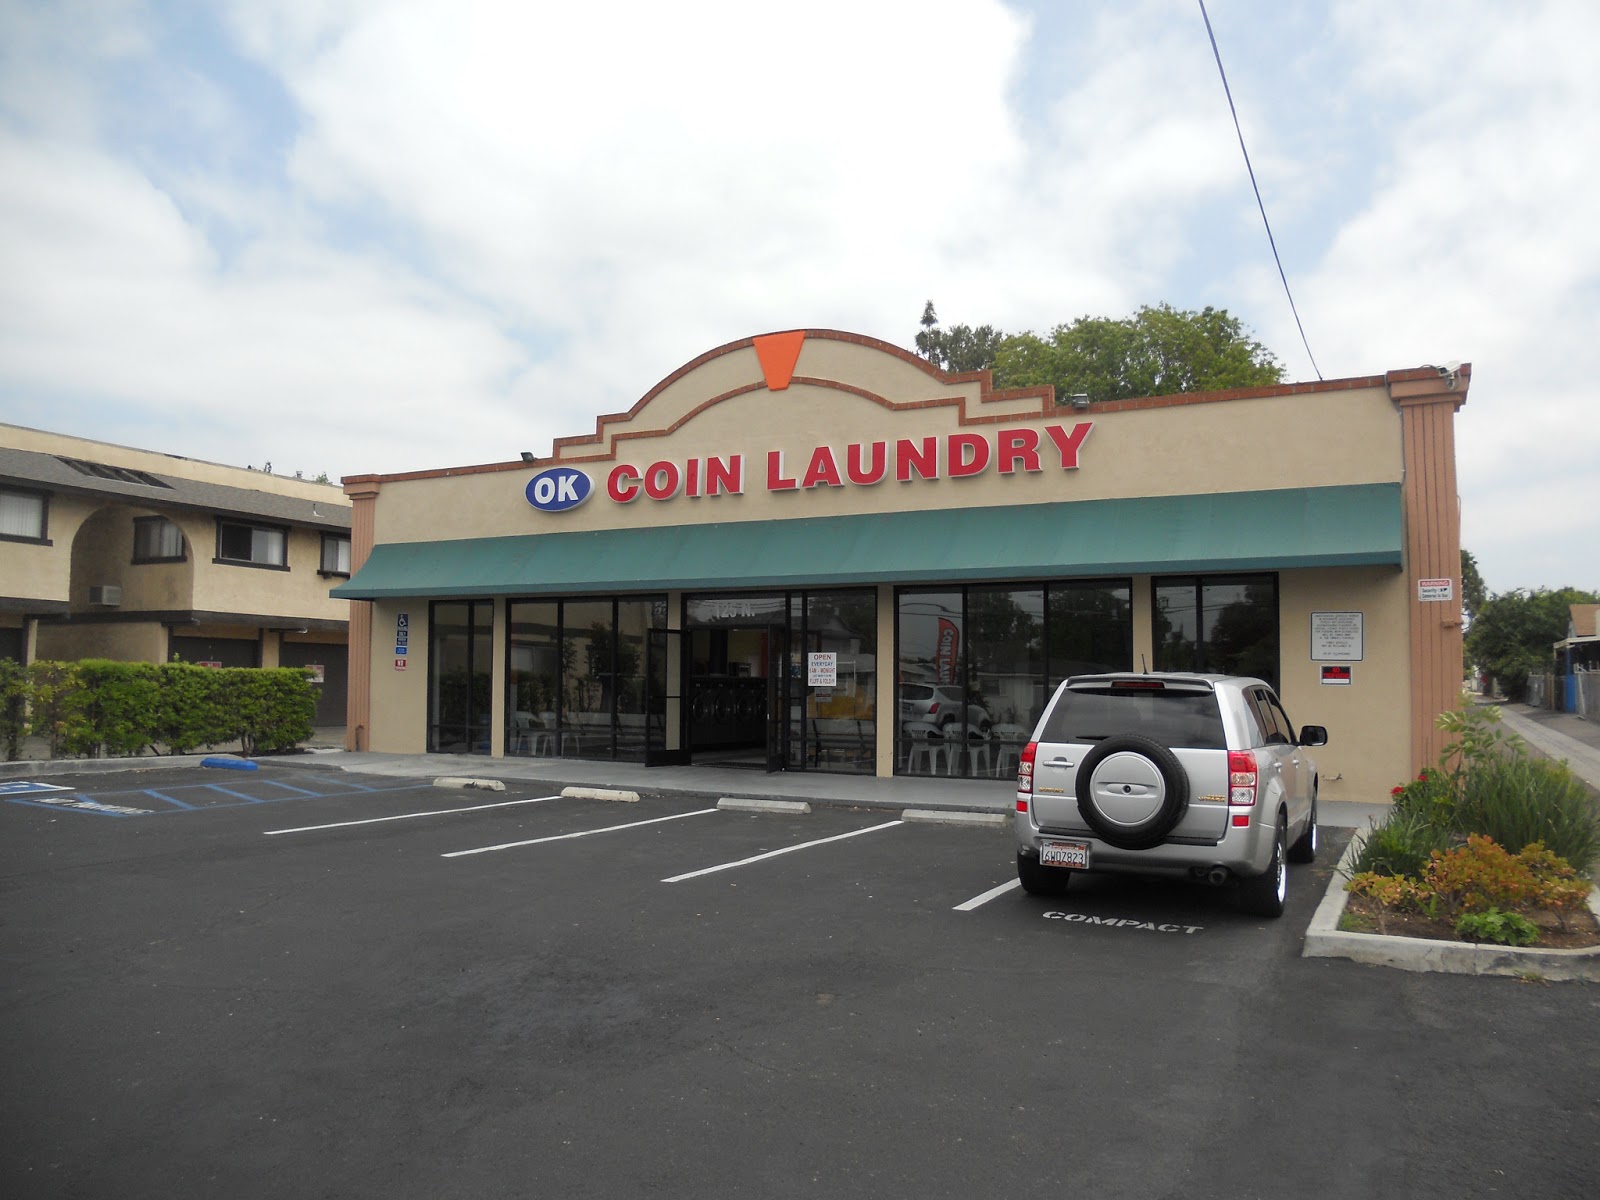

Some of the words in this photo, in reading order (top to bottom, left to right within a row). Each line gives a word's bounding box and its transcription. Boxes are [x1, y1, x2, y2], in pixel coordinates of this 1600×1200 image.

[535, 475, 578, 503] OK
[608, 456, 742, 501] COIN
[768, 422, 1093, 489] LAUNDRY
[940, 628, 954, 656] COIN
[1043, 912, 1203, 933] COMPACT
